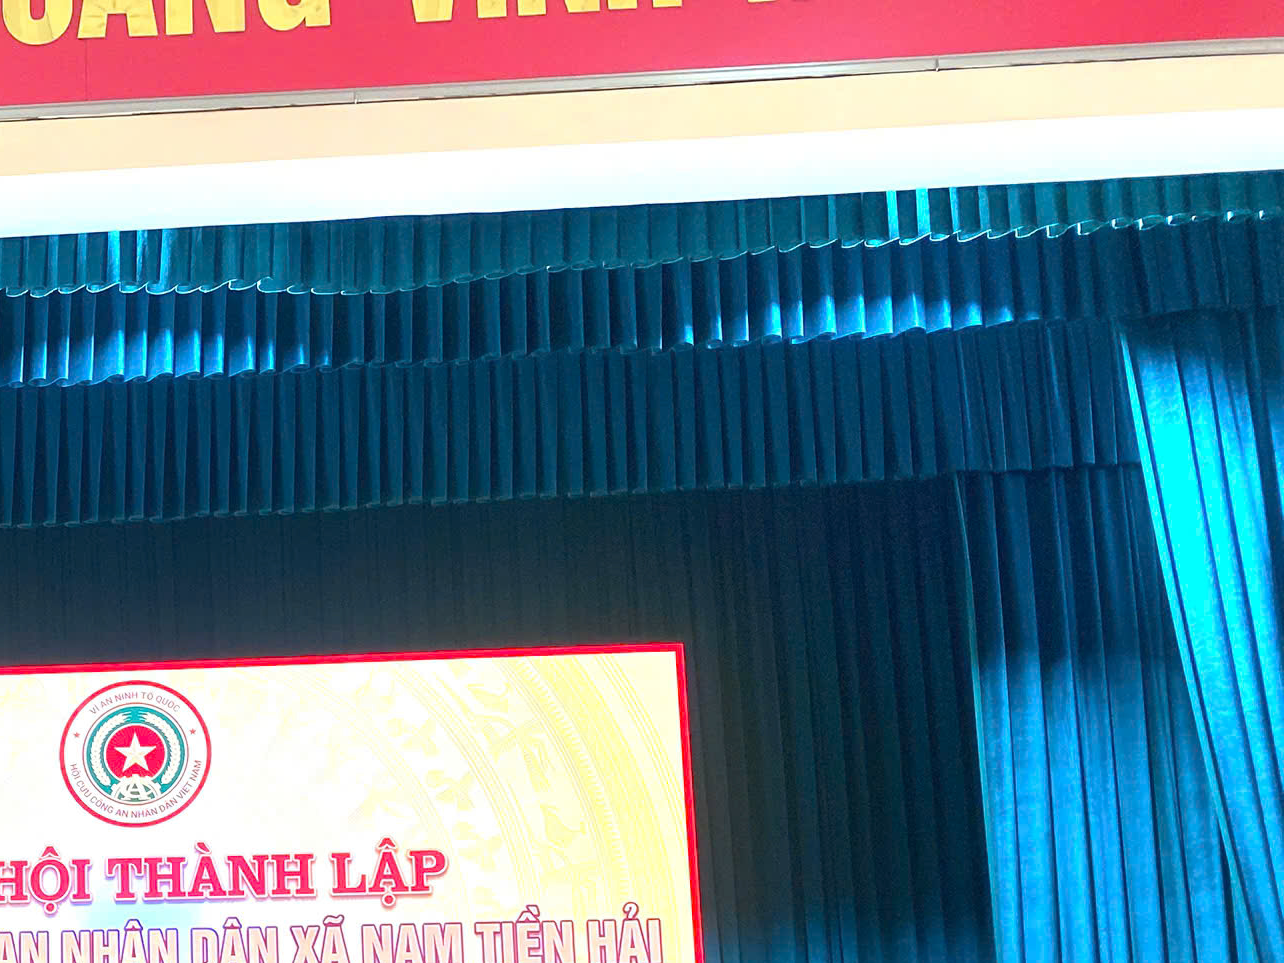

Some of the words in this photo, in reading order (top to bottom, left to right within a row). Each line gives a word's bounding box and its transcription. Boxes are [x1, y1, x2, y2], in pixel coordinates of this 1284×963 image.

[100, 698, 114, 709] AN
[114, 691, 139, 702] NINH
[115, 808, 129, 819] AN
[189, 759, 203, 782] NAM
[107, 842, 316, 903] THÀNH
[331, 838, 448, 908] LẬP
